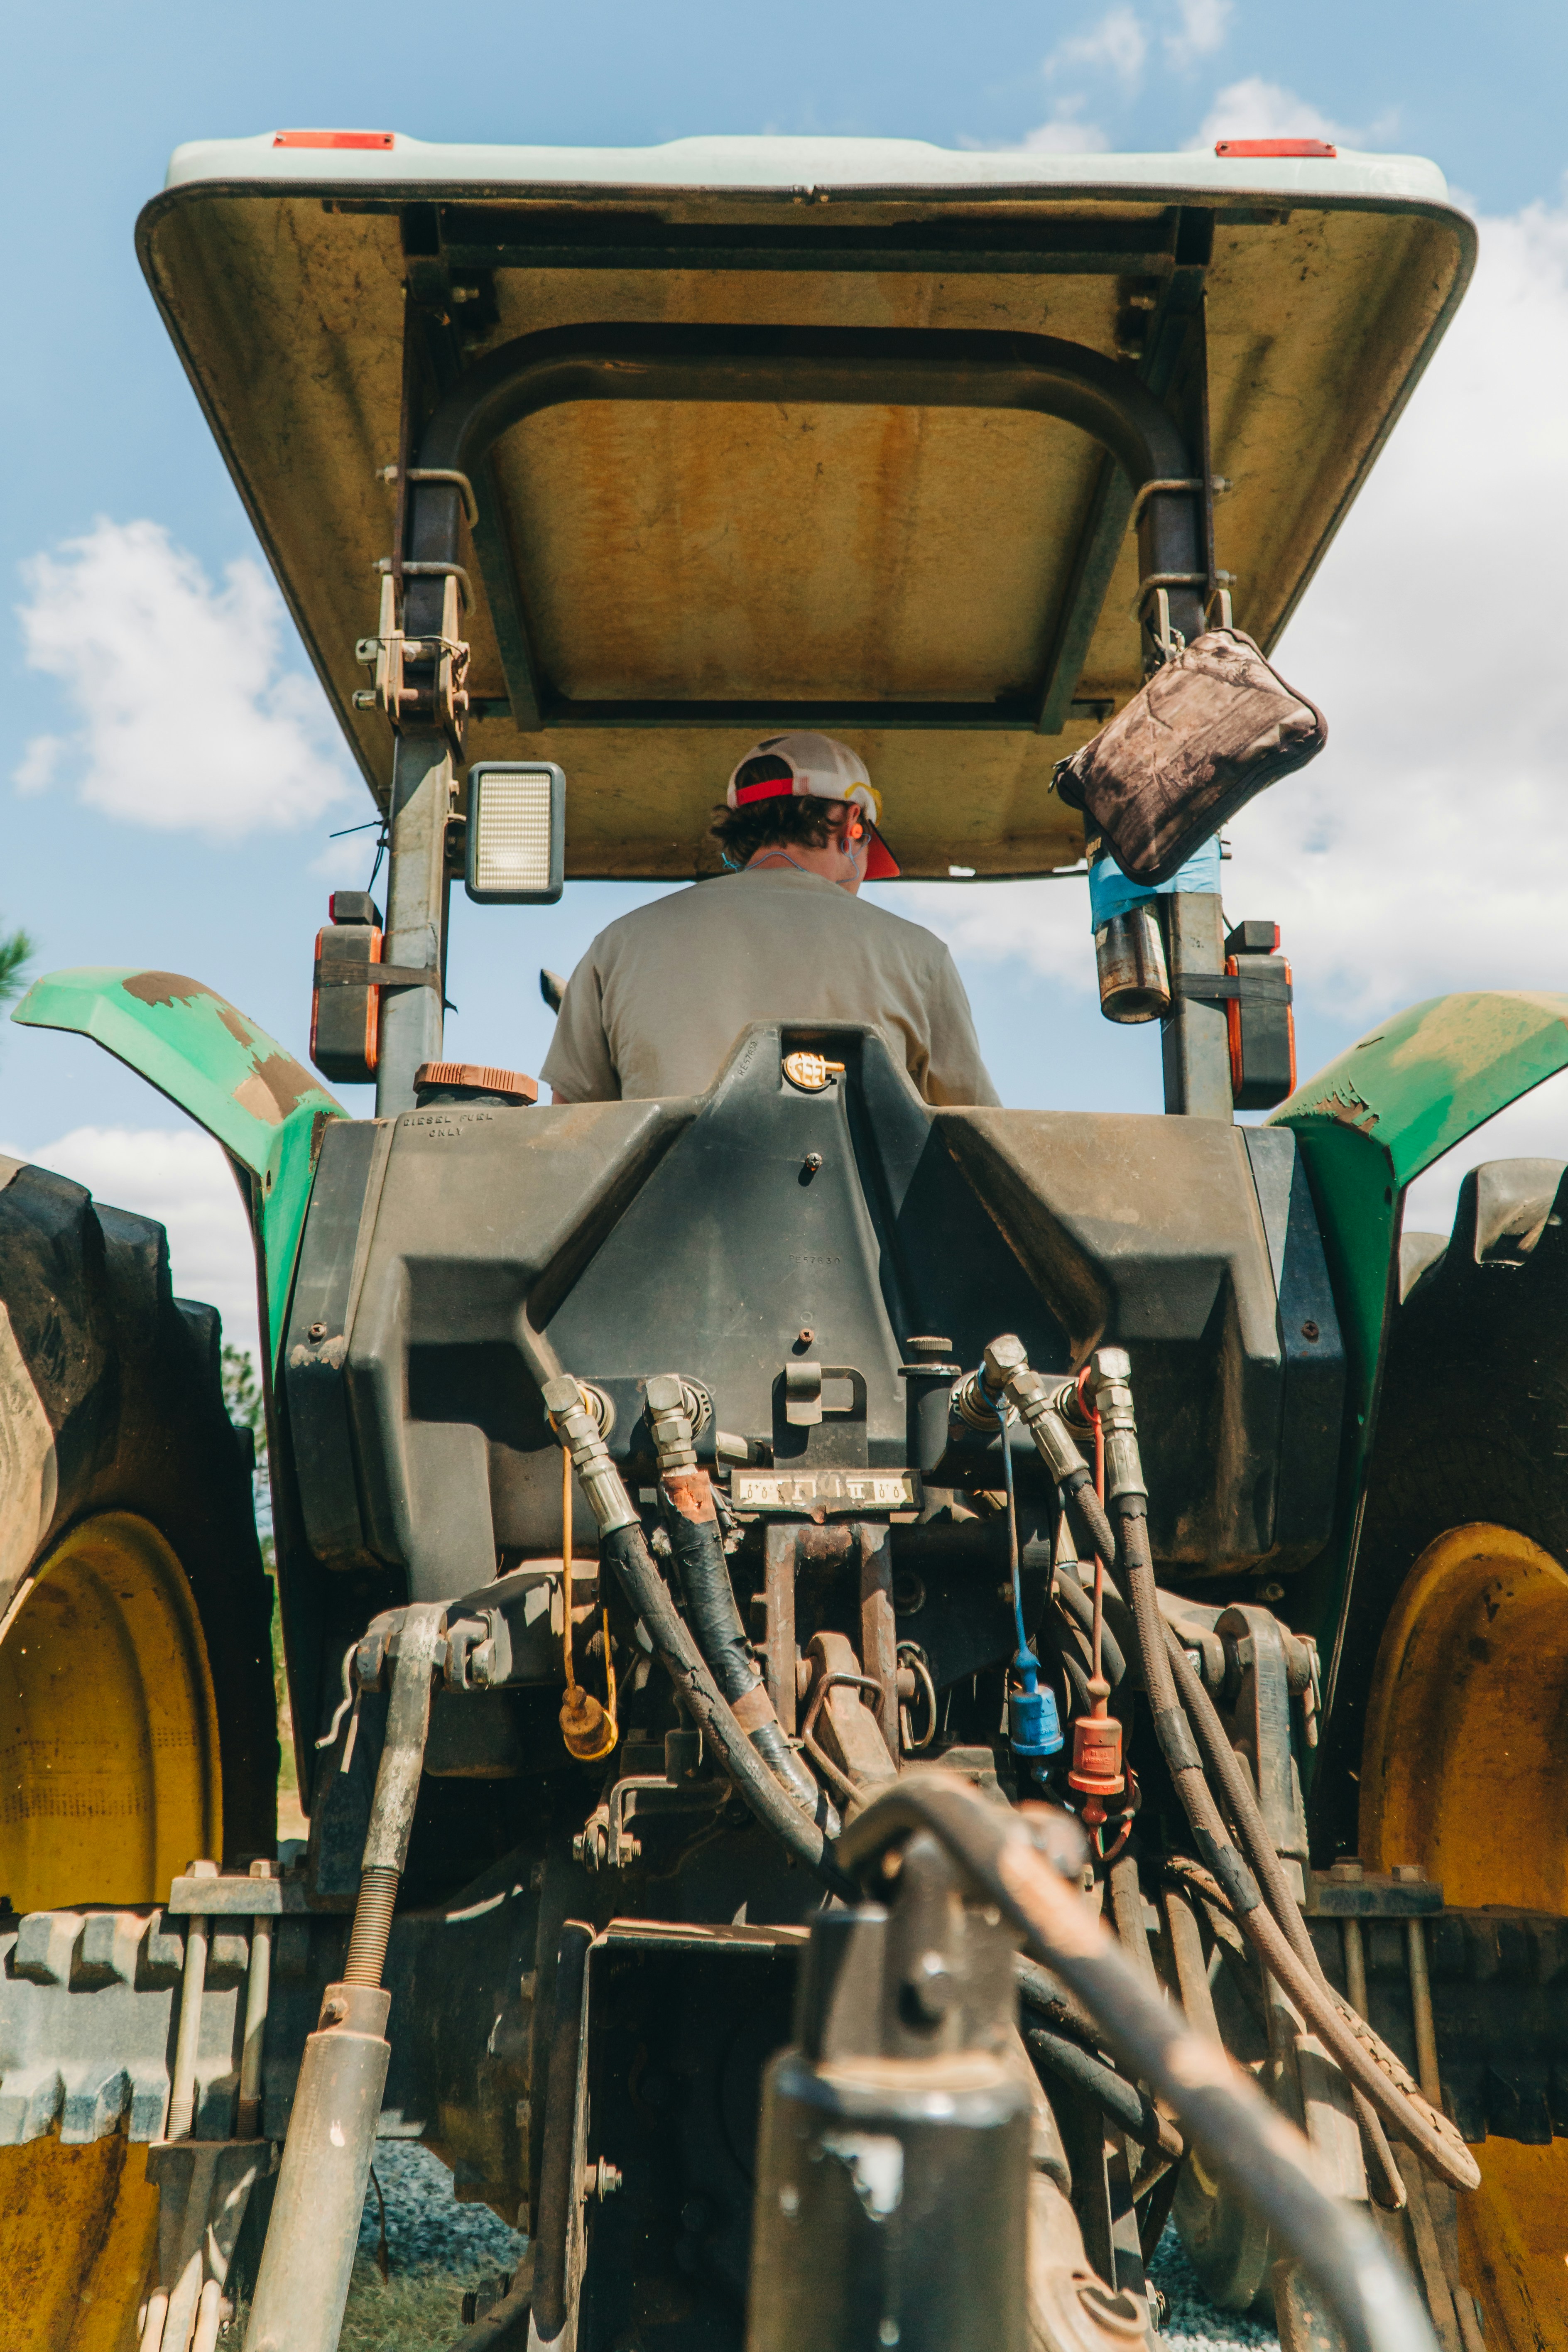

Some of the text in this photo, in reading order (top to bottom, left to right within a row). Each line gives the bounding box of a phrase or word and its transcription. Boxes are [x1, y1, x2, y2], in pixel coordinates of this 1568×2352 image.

[404, 1113, 493, 1126] DIESEL FUEL
[429, 1127, 463, 1137] ONLY
